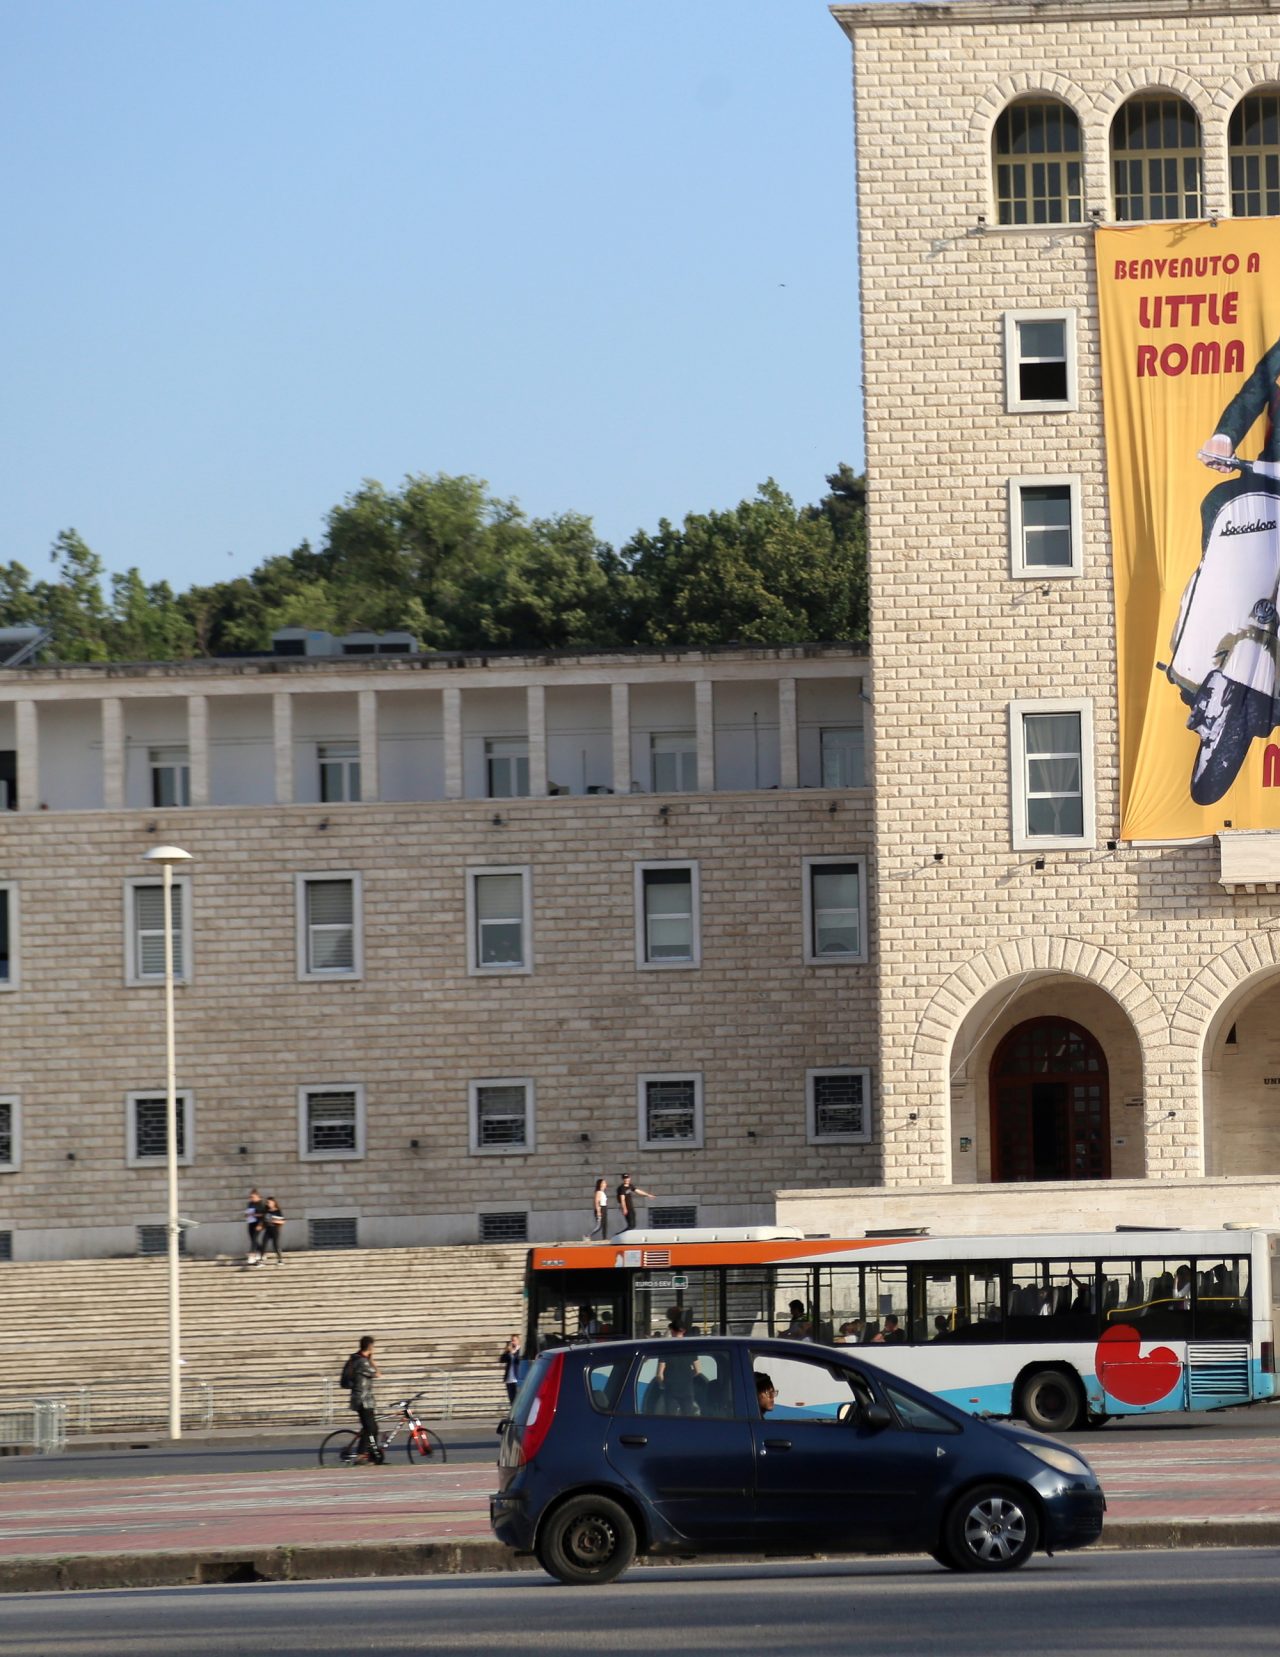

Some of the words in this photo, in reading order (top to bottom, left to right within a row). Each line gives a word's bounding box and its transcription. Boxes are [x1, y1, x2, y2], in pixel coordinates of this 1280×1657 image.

[1114, 254, 1239, 280] BENVENUTO
[1247, 253, 1260, 272] A
[1138, 291, 1239, 329] LITTLE
[1136, 339, 1245, 378] ROMA
